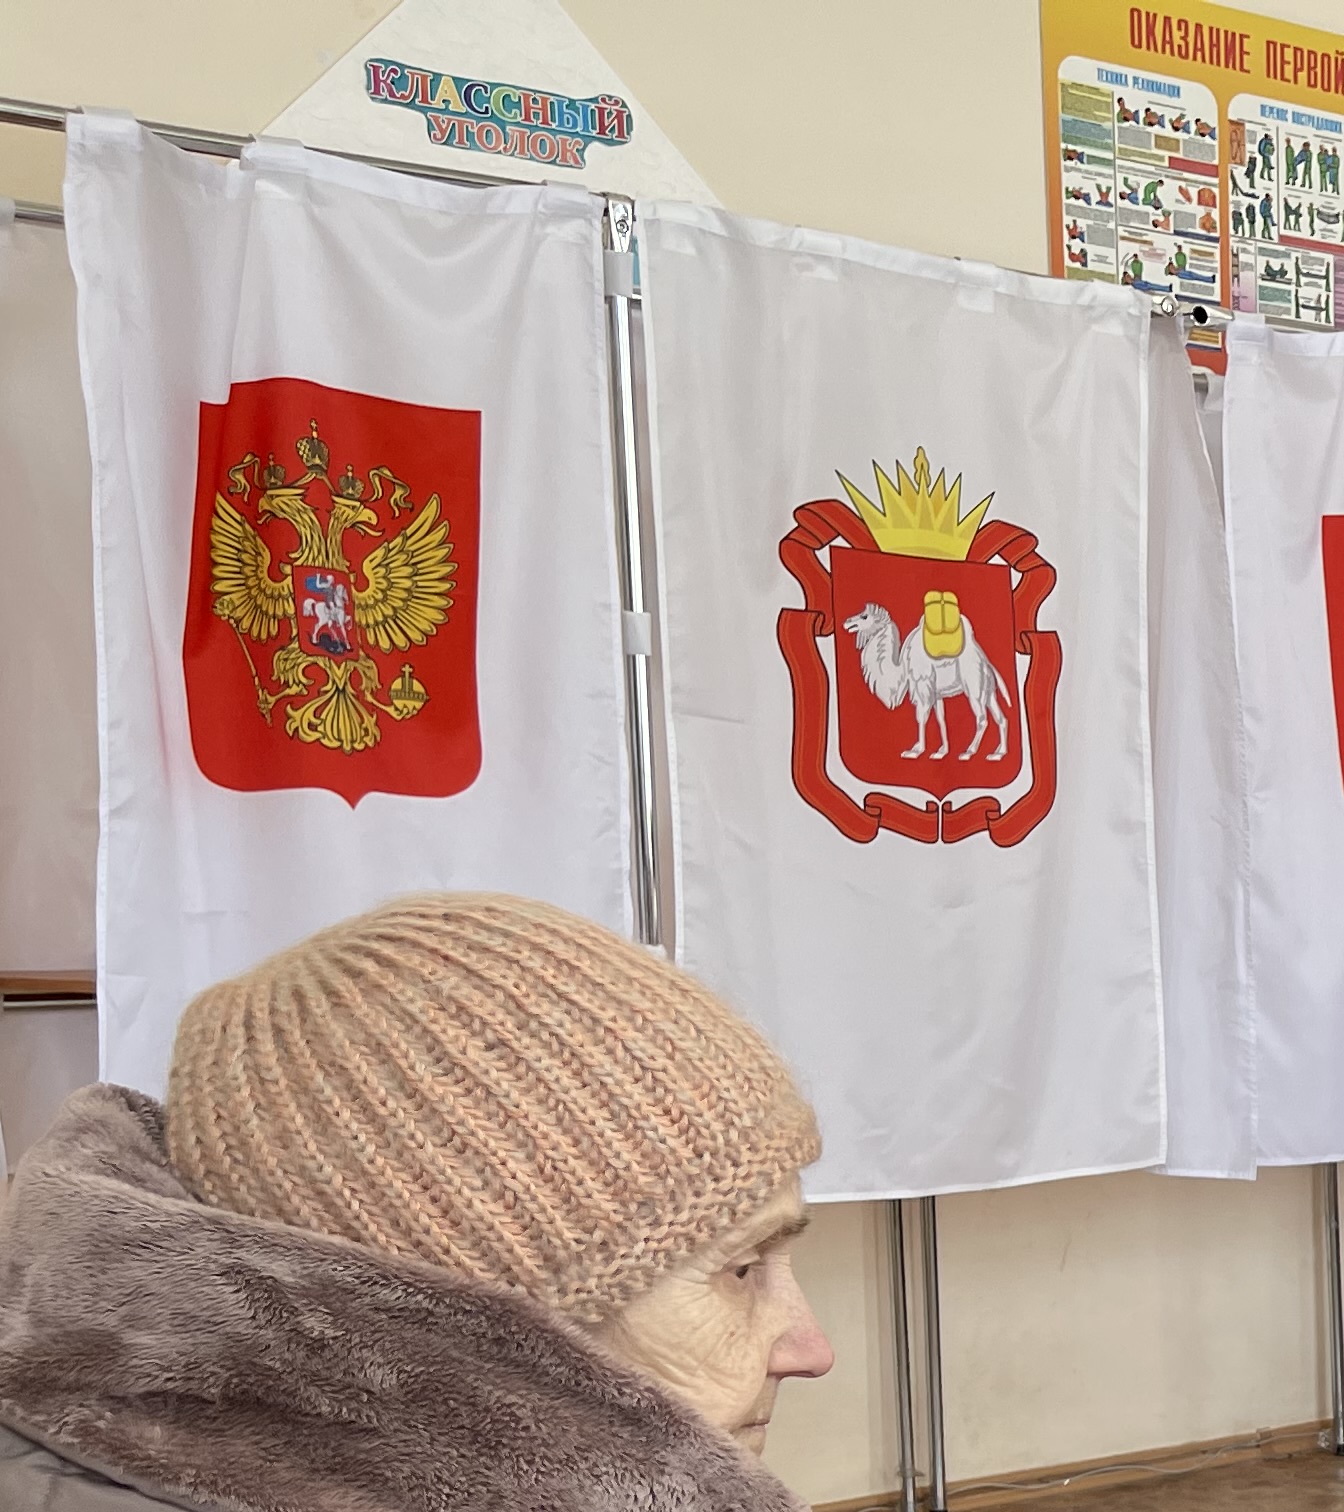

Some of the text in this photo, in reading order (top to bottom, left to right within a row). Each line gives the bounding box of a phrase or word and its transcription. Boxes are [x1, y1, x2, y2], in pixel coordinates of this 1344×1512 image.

[1129, 7, 1251, 74] ОКАЗАНИЕ
[367, 61, 631, 141] КЛАССНЫЙ
[427, 113, 584, 168] УГОЛОК
